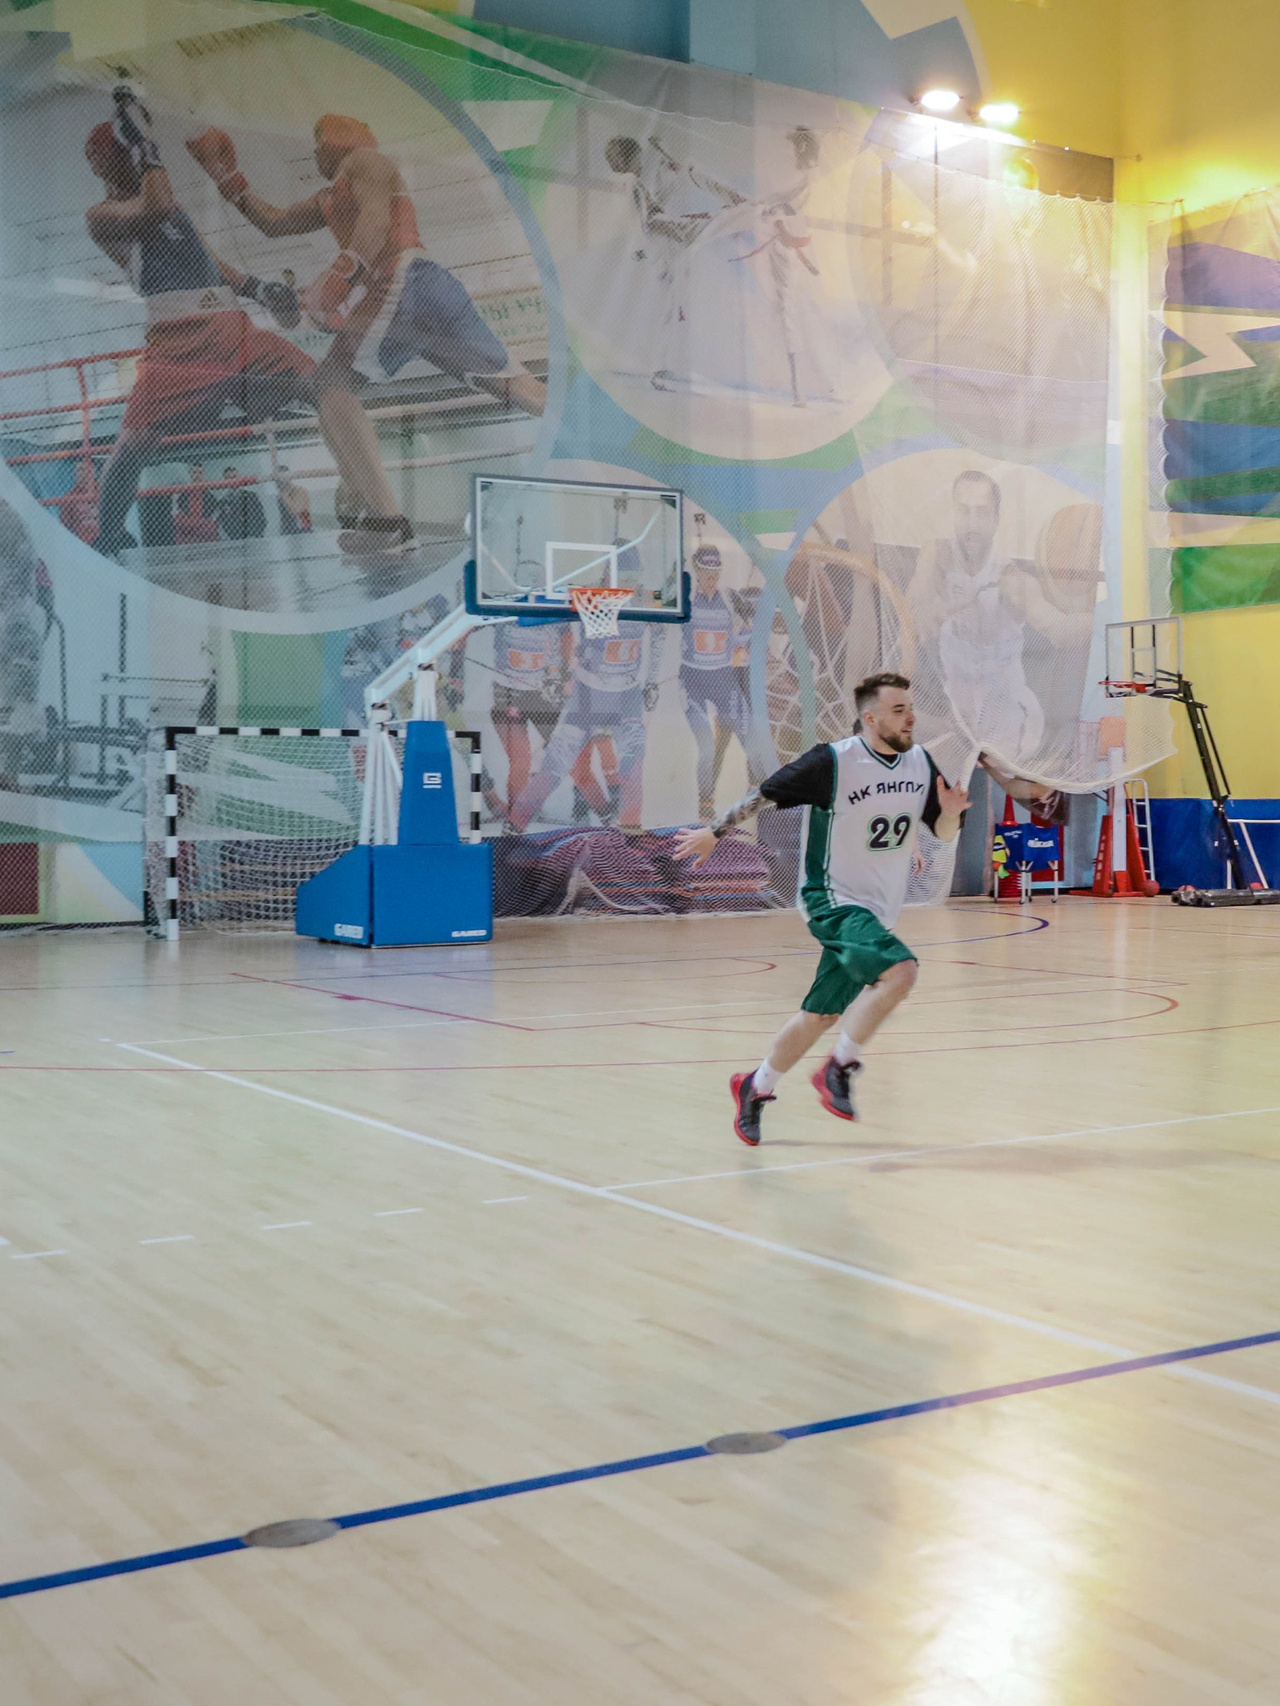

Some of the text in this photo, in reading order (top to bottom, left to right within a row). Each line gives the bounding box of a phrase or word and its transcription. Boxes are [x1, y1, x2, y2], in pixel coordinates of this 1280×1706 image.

[848, 781, 926, 805] НК ЯНГПУ
[868, 813, 911, 851] 29
